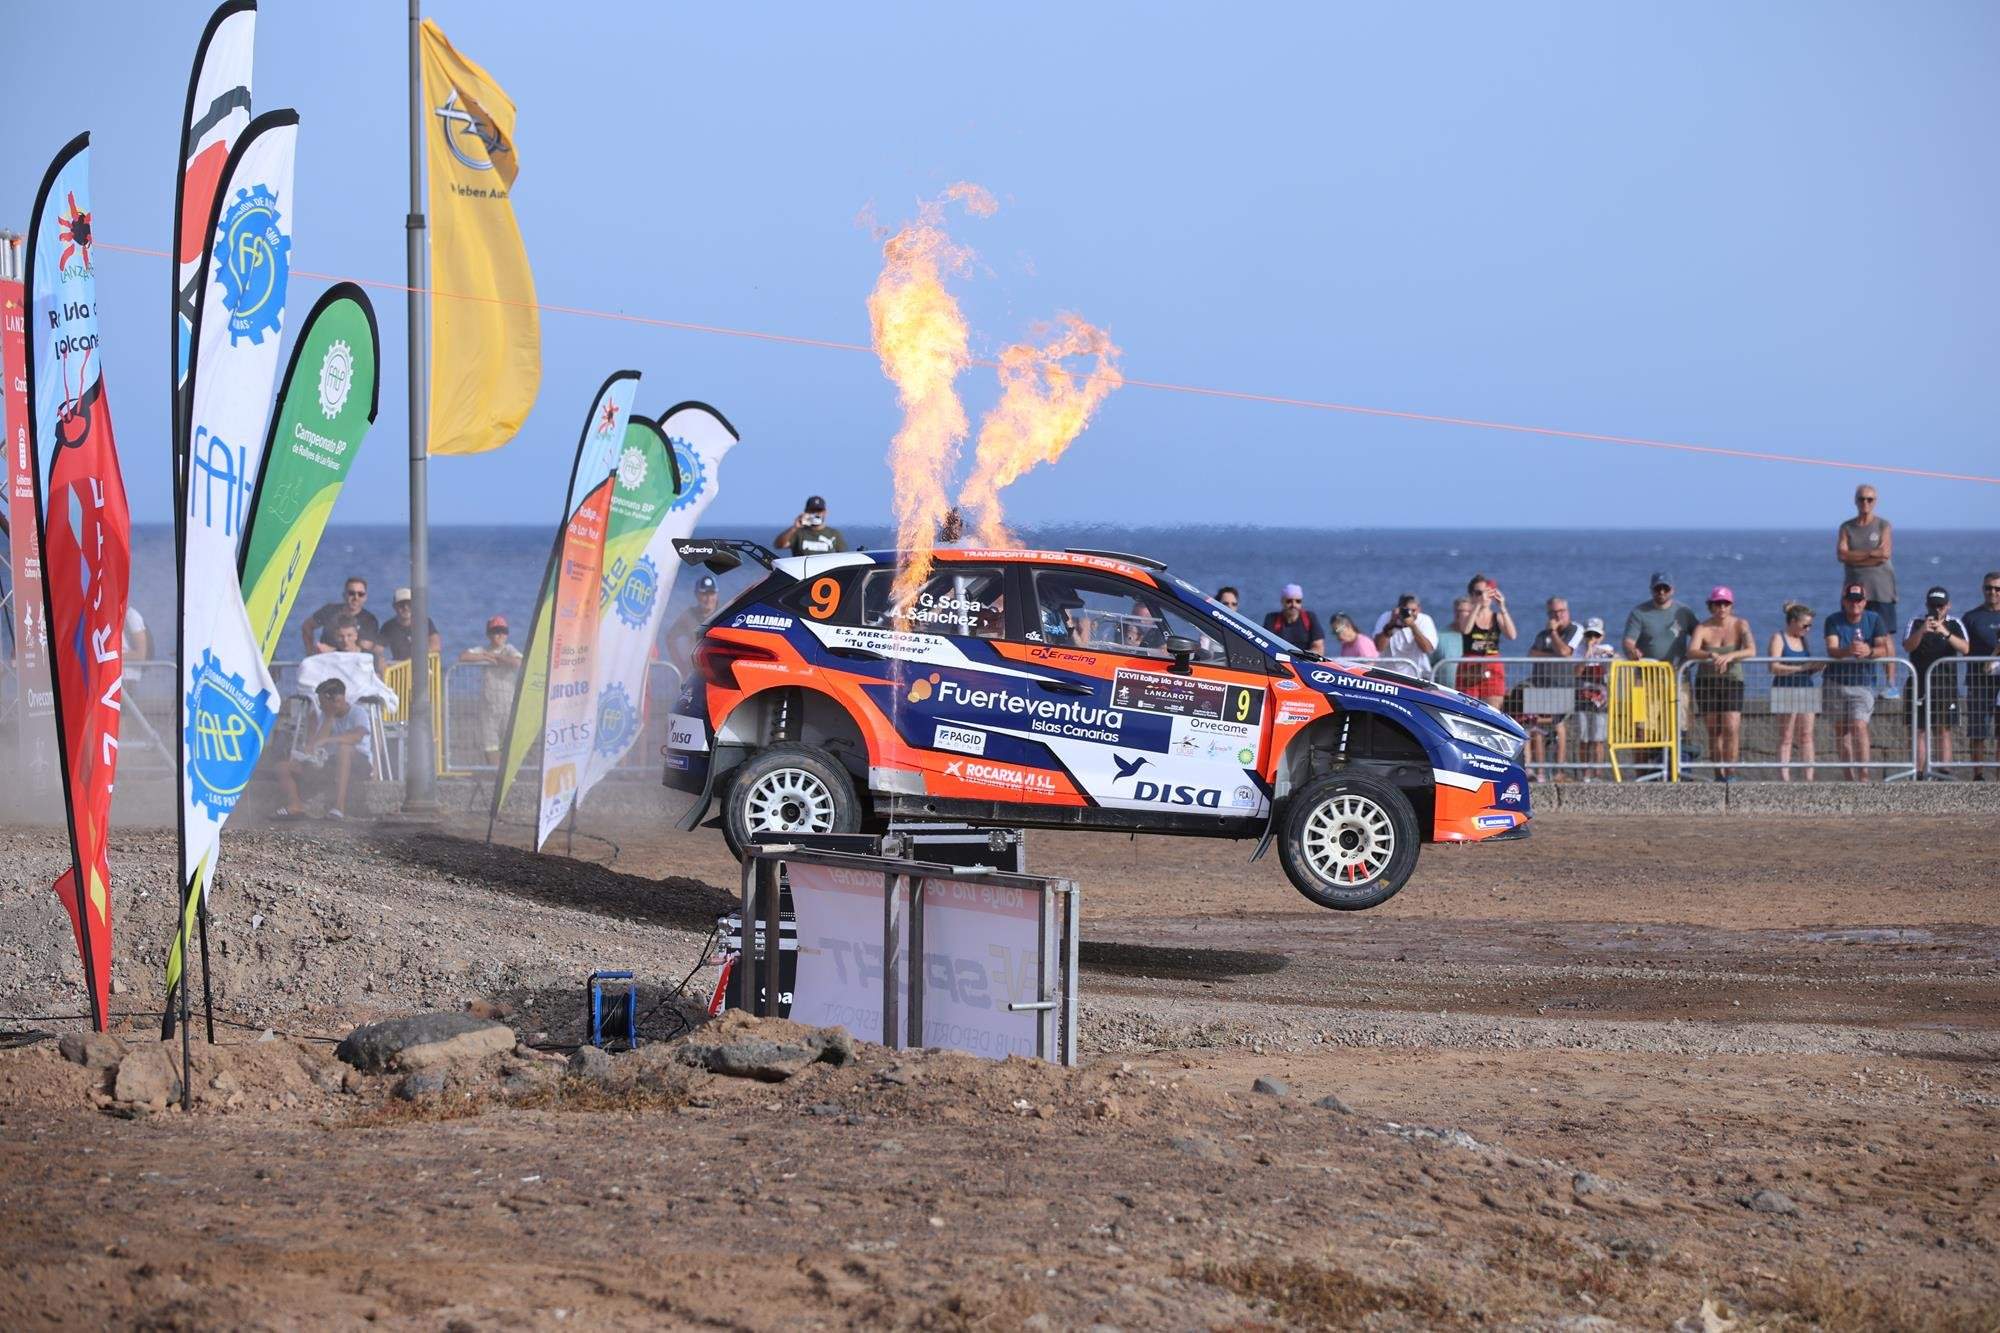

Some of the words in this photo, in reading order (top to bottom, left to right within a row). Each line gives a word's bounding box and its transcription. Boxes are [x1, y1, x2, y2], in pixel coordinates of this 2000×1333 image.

[807, 576, 841, 620] 9
[919, 592, 981, 612] G.Sosa
[745, 614, 793, 628] GALIMAR
[835, 628, 853, 636] E.S.
[924, 637, 943, 646] S.L.
[1117, 671, 1140, 682] XXVII
[1139, 674, 1160, 685] Rallye
[1337, 675, 1399, 696] HYUNDAI
[938, 681, 1123, 729] Fuerteventura
[1144, 689, 1195, 702] LANZAROTE
[1236, 689, 1251, 722] 9
[1031, 719, 1061, 734] Islas
[1062, 723, 1120, 743] Canarias
[1190, 718, 1249, 735] Orvecame
[949, 731, 982, 745] PAGID
